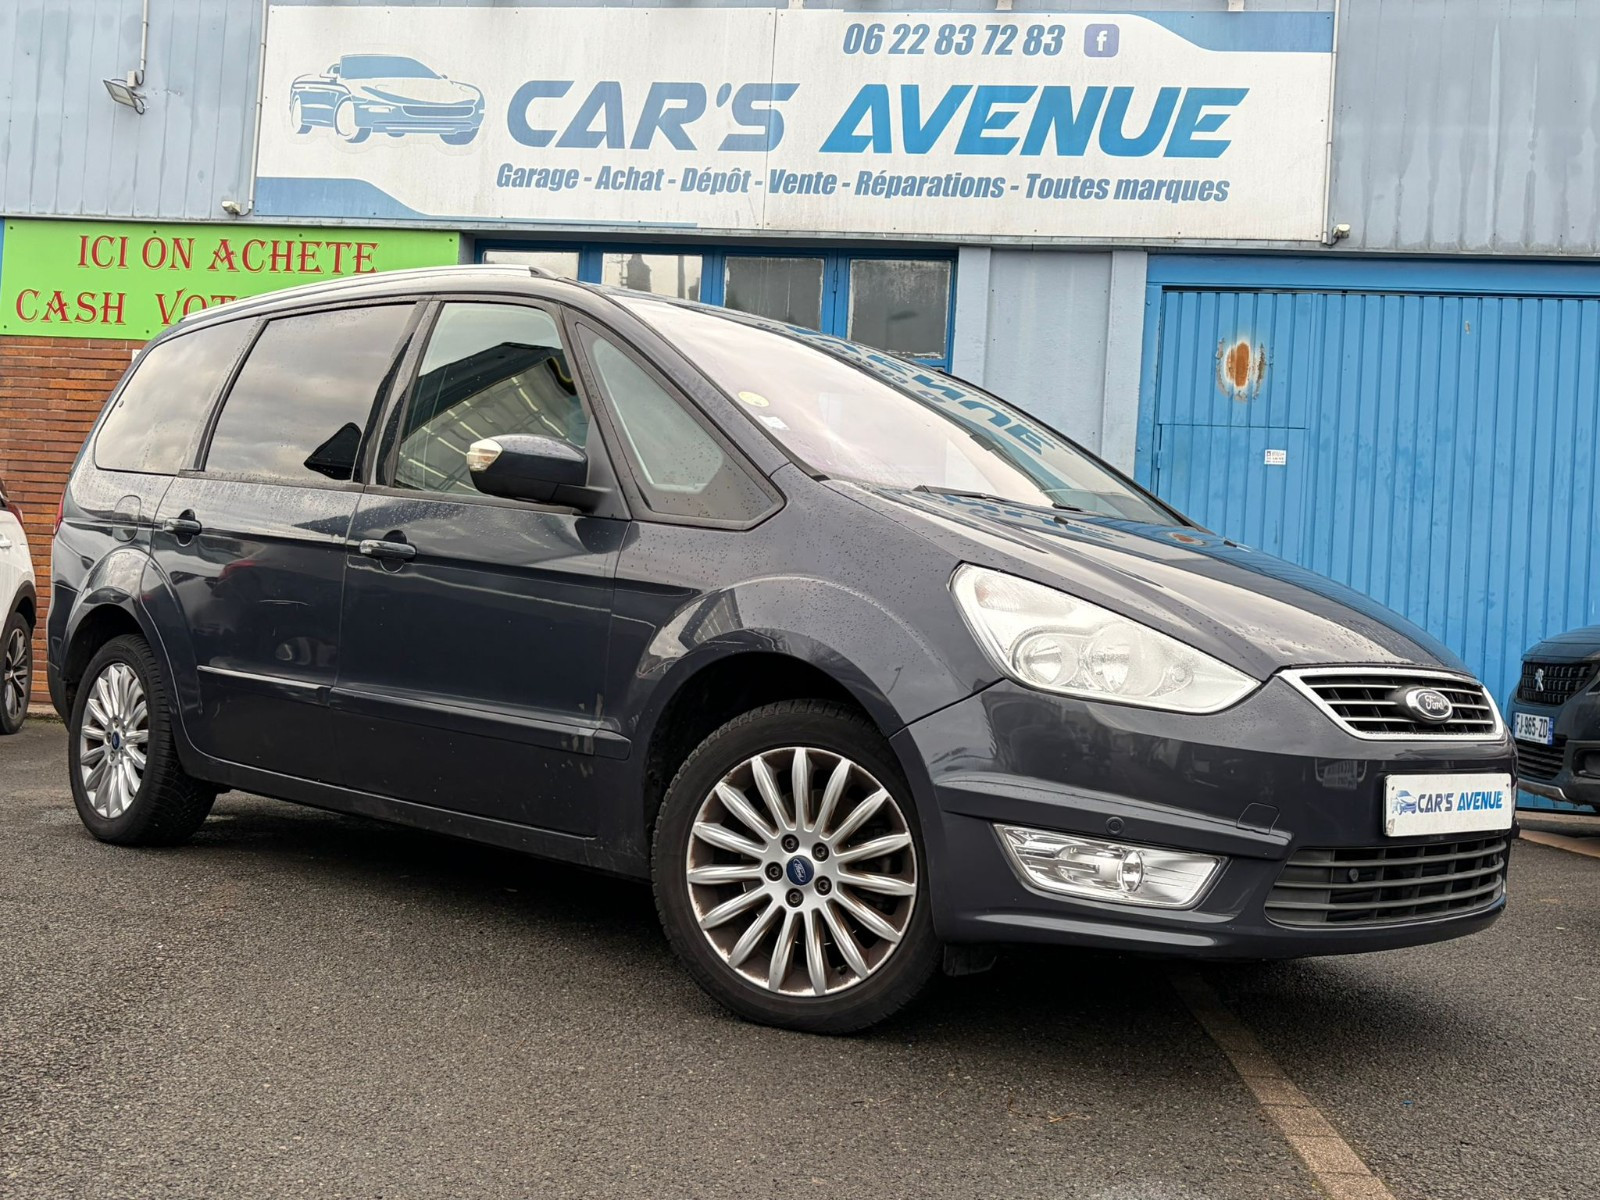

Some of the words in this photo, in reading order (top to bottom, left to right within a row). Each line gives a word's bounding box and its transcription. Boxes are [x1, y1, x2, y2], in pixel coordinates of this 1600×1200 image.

[843, 23, 885, 55] 06
[888, 23, 930, 55] 22
[933, 24, 977, 56] 83
[981, 24, 1018, 56] 72
[1022, 24, 1066, 56] 83
[506, 80, 800, 152] CAR'S
[818, 84, 1250, 158] AVENUE
[496, 163, 579, 192] Garage
[595, 166, 665, 191] Achat
[680, 167, 752, 195] Dépôt
[769, 169, 838, 195] Vente
[855, 170, 1006, 199] Réparations
[1026, 173, 1110, 199] Toutes
[1113, 178, 1230, 203] marques
[78, 235, 128, 269] ICI
[142, 237, 195, 270] ON
[207, 238, 378, 275] ACHETE
[16, 288, 127, 326] CASH
[155, 287, 251, 326] VOT
[1418, 793, 1454, 813] CAR'S
[1457, 791, 1504, 811] AVENUE
